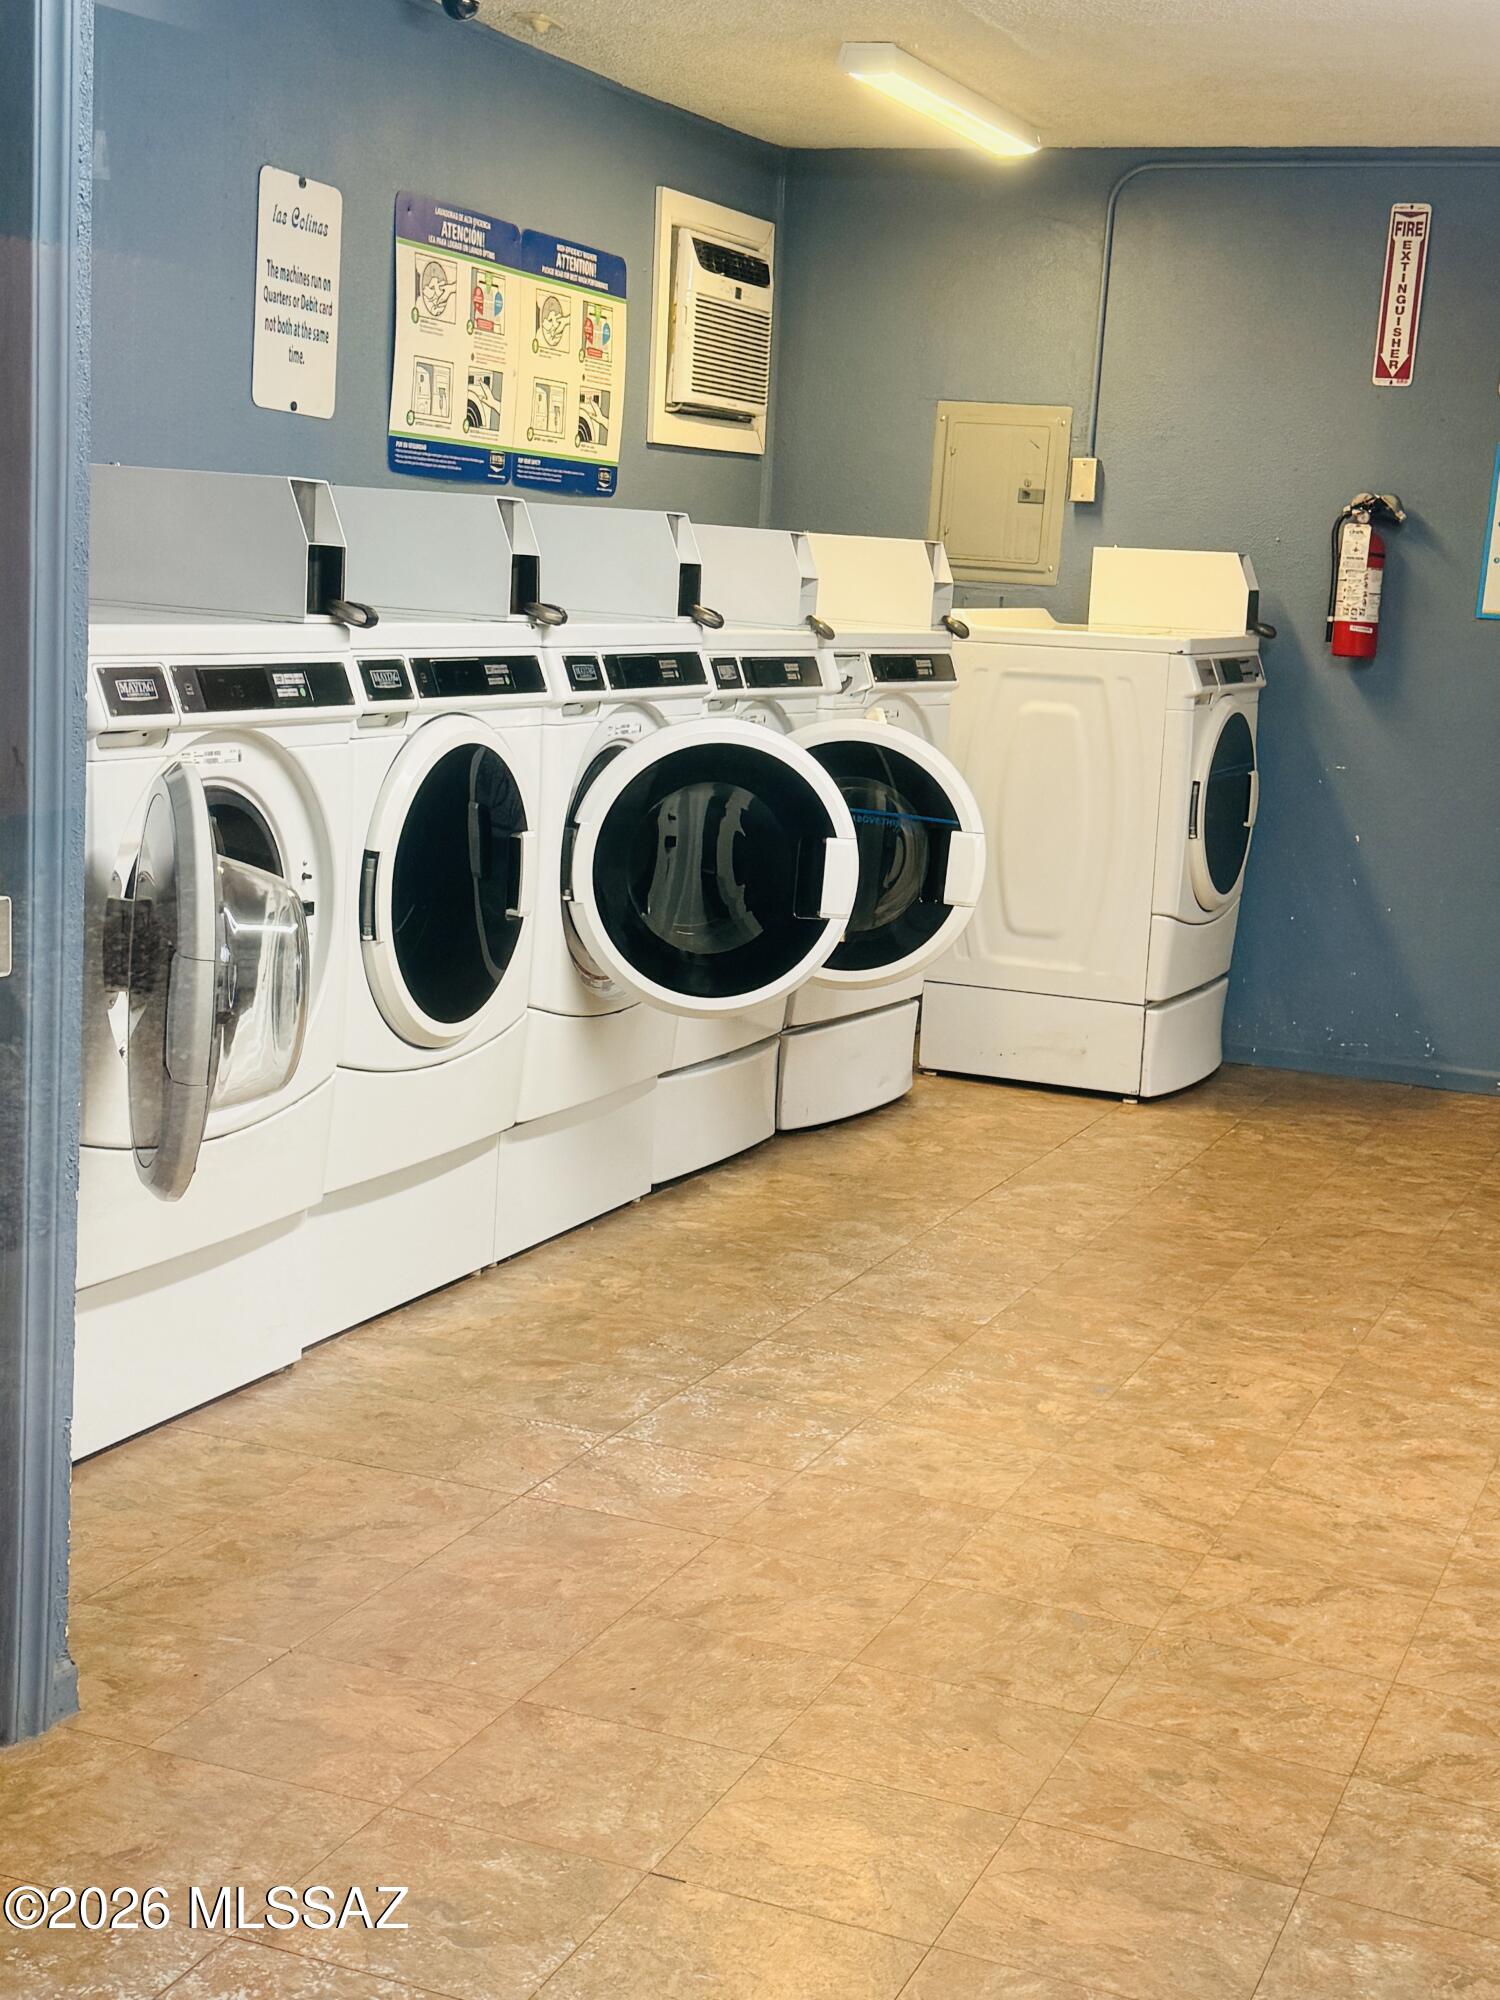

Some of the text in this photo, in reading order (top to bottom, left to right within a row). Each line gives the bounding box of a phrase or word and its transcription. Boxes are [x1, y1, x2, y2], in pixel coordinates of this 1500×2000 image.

[272, 203, 329, 237] las Colinas
[441, 221, 485, 246] ATENCIÓN!
[1395, 221, 1424, 237] FIRE
[266, 258, 331, 292] The machines run on
[555, 253, 596, 278] ATTENTION!
[263, 285, 333, 317] Quarters or Debit card
[1388, 240, 1412, 370] EXTINGUISHER
[264, 314, 330, 344] not both at the same
[288, 344, 305, 365] time.
[118, 681, 154, 694] MAYTAG
